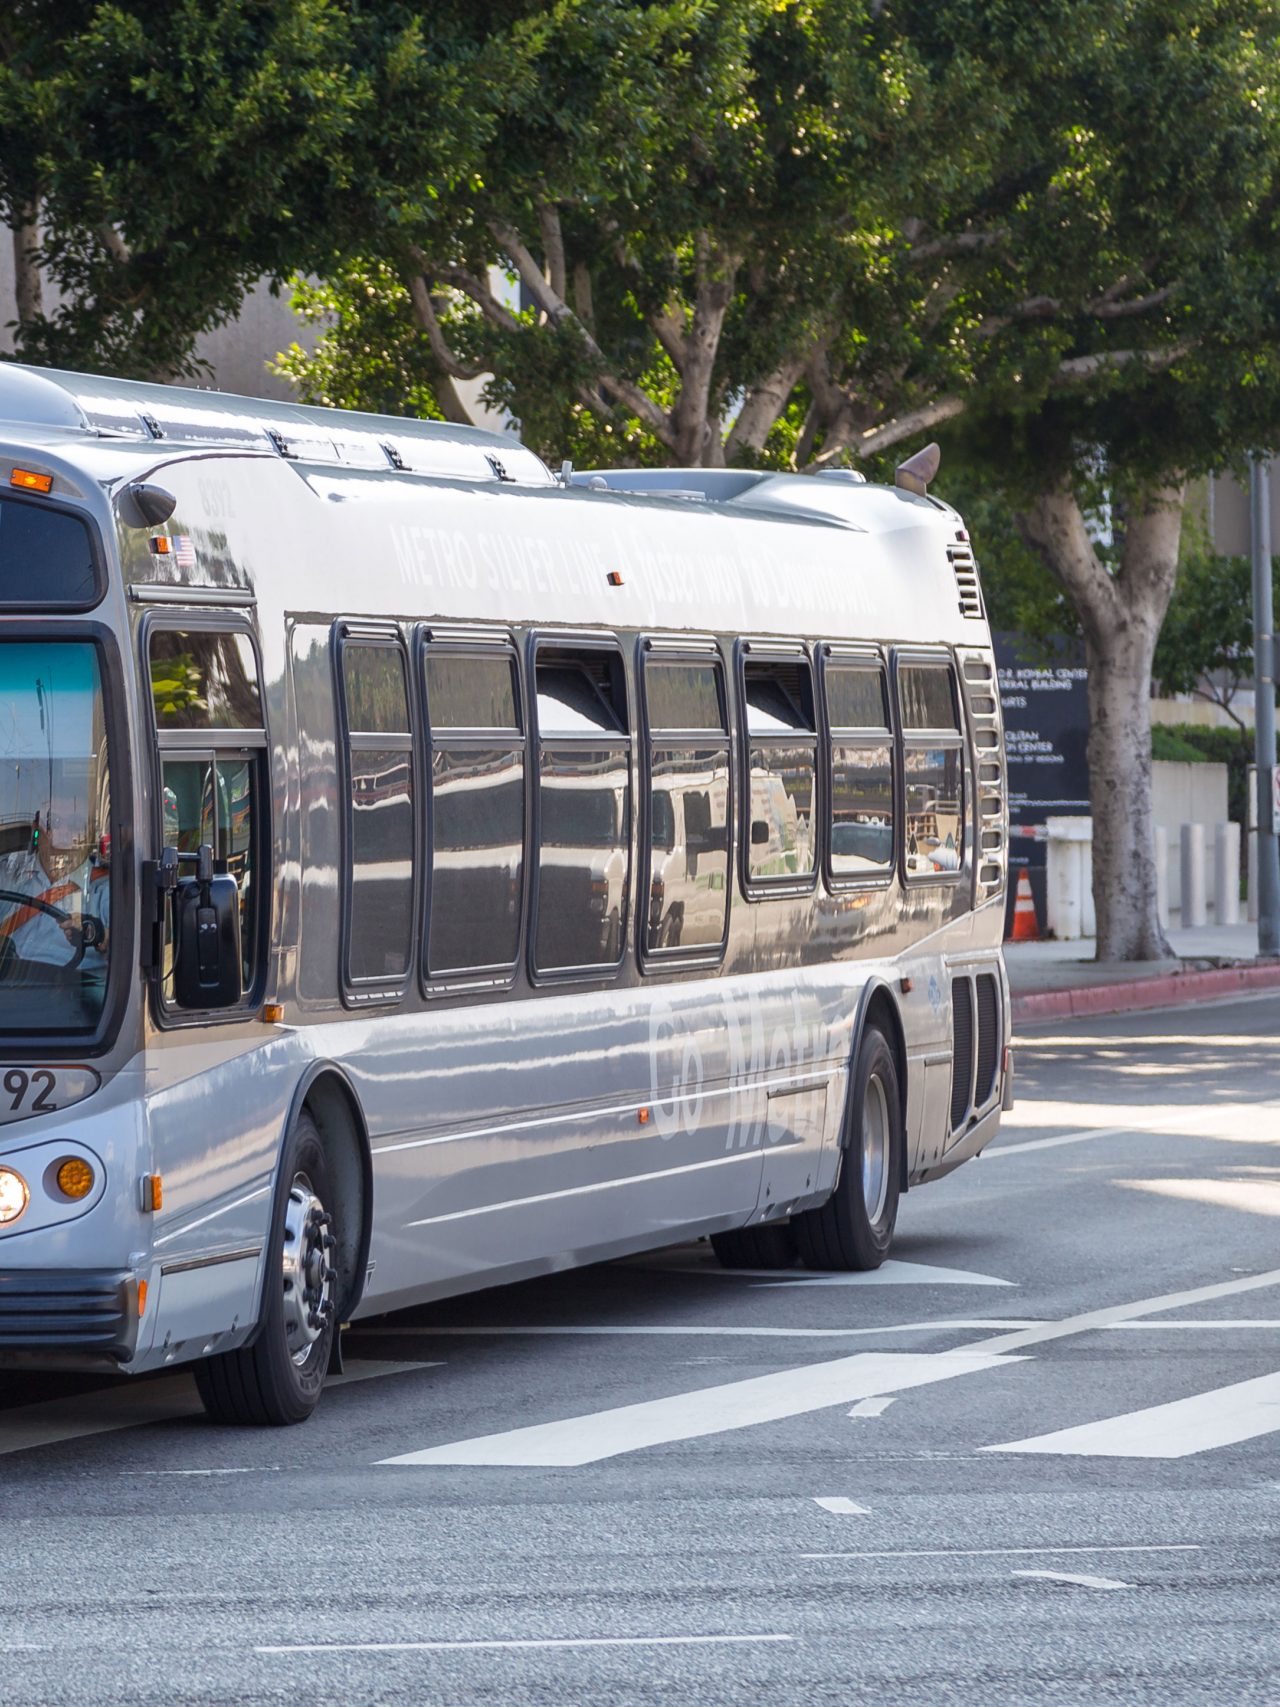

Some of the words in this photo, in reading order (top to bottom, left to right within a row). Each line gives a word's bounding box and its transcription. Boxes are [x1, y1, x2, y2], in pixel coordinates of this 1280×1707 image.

[389, 522, 477, 590] METRO
[476, 532, 561, 594] SILVER
[556, 539, 617, 598] LINE
[1031, 680, 1073, 691] BUILDING
[648, 997, 704, 1143] Go
